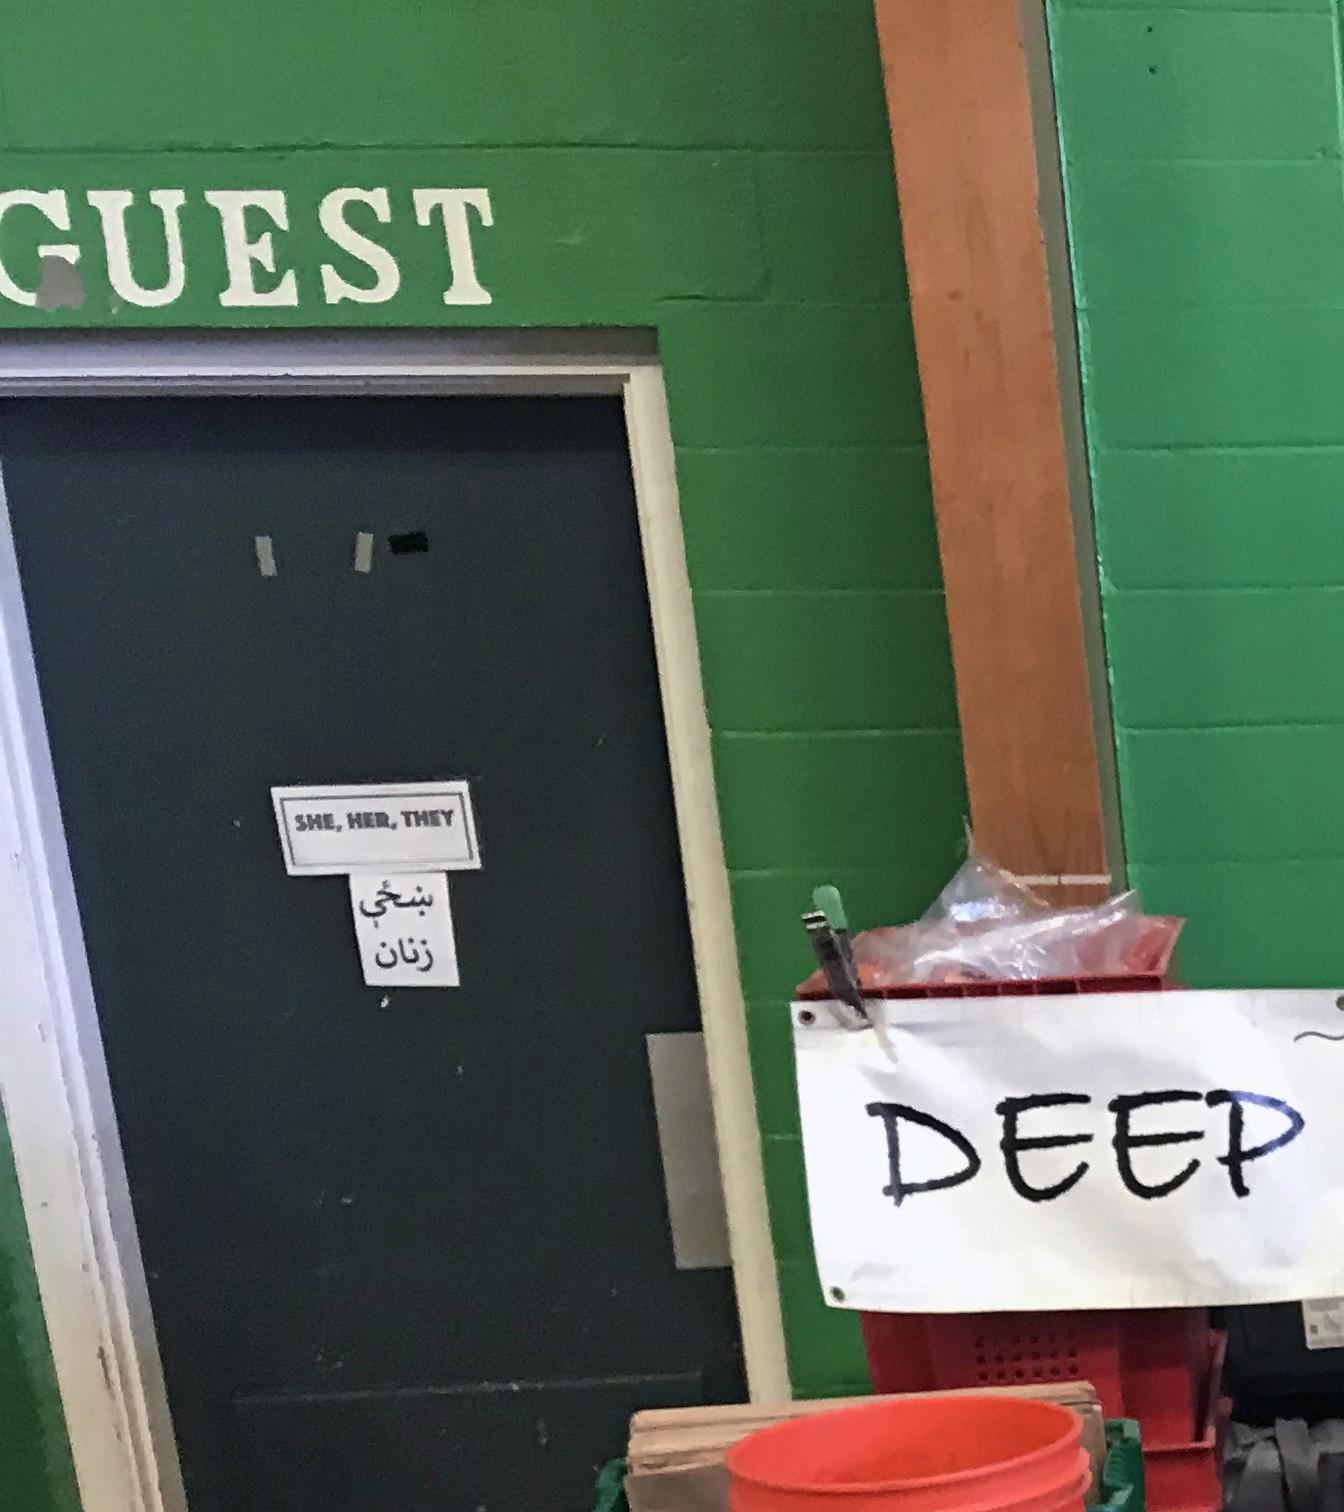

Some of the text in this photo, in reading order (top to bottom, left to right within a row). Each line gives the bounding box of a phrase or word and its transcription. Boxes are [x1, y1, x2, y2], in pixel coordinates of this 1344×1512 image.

[0, 187, 494, 308] GUEST
[294, 809, 454, 833] SHE, HER, THEY
[375, 937, 433, 973] زنان
[865, 1088, 1306, 1207] DEEP
